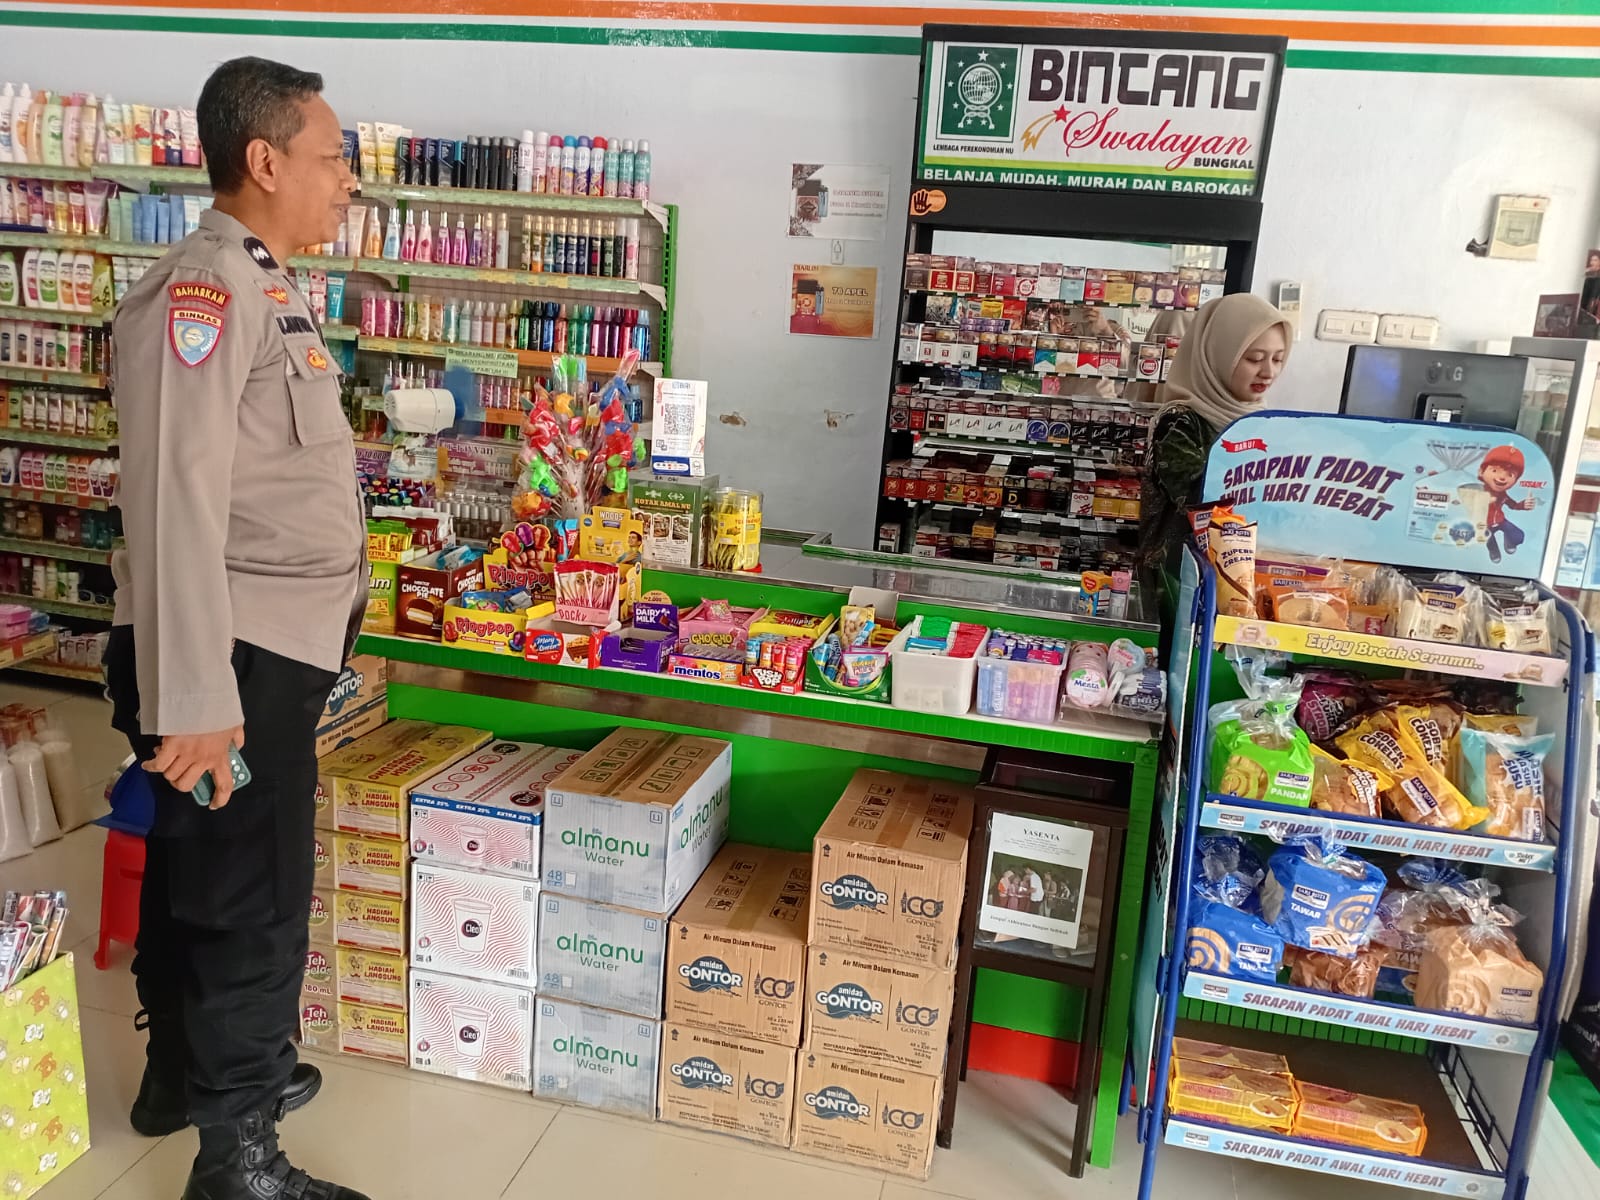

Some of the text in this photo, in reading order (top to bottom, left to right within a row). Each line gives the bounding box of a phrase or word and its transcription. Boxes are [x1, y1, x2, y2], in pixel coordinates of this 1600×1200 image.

[1028, 49, 1265, 111] BINTANG
[1063, 107, 1252, 171] Swalayan
[933, 144, 959, 152] LEMBAGA
[960, 145, 1005, 154] PEREKONOMIAN
[1193, 157, 1254, 169] BUNGKAL
[924, 168, 995, 183] BELANJA
[1067, 175, 1127, 189] MURAH
[1132, 178, 1166, 191] DAN
[1171, 180, 1255, 196] BAROKAH
[175, 286, 226, 305] BAHARKAM
[179, 311, 217, 324] BINMAS
[1234, 440, 1256, 452] BARU!
[1223, 455, 1405, 494] SARAPAN PADAT
[1262, 483, 1311, 503] HARI
[1313, 486, 1395, 521] HEBAT
[1224, 556, 1252, 568] CREAM
[402, 584, 444, 598] CHOCOLATE
[636, 608, 661, 617] DAIRY
[636, 616, 656, 624] MILK
[1306, 633, 1354, 655] Enjoy
[1357, 642, 1407, 661] Break
[674, 666, 720, 680] mentos
[325, 673, 363, 704] ONTOR
[1375, 732, 1406, 760] SOBEK
[1410, 718, 1434, 766] COKELA
[1426, 720, 1441, 760] SOBEK
[1360, 734, 1404, 770] COKELAT
[1504, 760, 1523, 790] SUSU
[1270, 788, 1308, 800] PANDAN
[362, 800, 400, 808] LANGSUNG
[416, 797, 435, 805] EXTRA
[456, 804, 476, 812] EXTRA
[680, 786, 723, 850] almanu
[560, 827, 650, 857] almanu
[692, 824, 712, 852] Water
[1024, 828, 1060, 841] YASENTA
[1372, 832, 1408, 848] AWAL
[1414, 839, 1446, 852] HARI
[1450, 844, 1494, 858] HEBAT
[362, 859, 400, 868] LANGSUNG
[366, 852, 392, 860] HADIAH
[584, 851, 624, 867] Water
[856, 853, 876, 862] Minum
[878, 856, 896, 866] Dalam
[896, 860, 924, 870] Kemasan
[546, 870, 562, 882] 48
[842, 878, 868, 888] amidas
[821, 882, 888, 905] GONTOR
[366, 908, 393, 916] HADIAH
[1290, 903, 1321, 919] TAWAR
[362, 915, 400, 924] LANGSUNG
[556, 933, 644, 964] almanu
[1396, 951, 1422, 962] TAW
[307, 954, 326, 966] Teh
[580, 956, 620, 972] Water
[364, 972, 402, 982] LANGSUNG
[678, 964, 743, 988] GONTOR
[852, 961, 872, 970] Minum
[873, 964, 892, 974] Dalam
[892, 968, 919, 979] Kemasan
[544, 973, 560, 984] 48
[304, 984, 318, 993] 180
[838, 987, 863, 998] amidas
[816, 992, 883, 1014] GONTOR
[308, 1008, 327, 1018] Teh
[1242, 992, 1478, 1040] SARAPAN PADAT AWAL HARI HEBAT
[304, 1017, 333, 1028] Gelas
[366, 1024, 404, 1034] LANGSUNG
[370, 1018, 397, 1026] HADIAH
[552, 1035, 638, 1068] almanu
[576, 1058, 614, 1075] Water
[831, 1062, 905, 1084] Air Minum Dalam Kemasan
[540, 1074, 554, 1084] 48
[672, 1064, 734, 1087] GONTOR
[804, 1094, 870, 1117] GONTOR
[1223, 1140, 1447, 1188] SARAPAN PADAT AWAL HARI HEBAT
